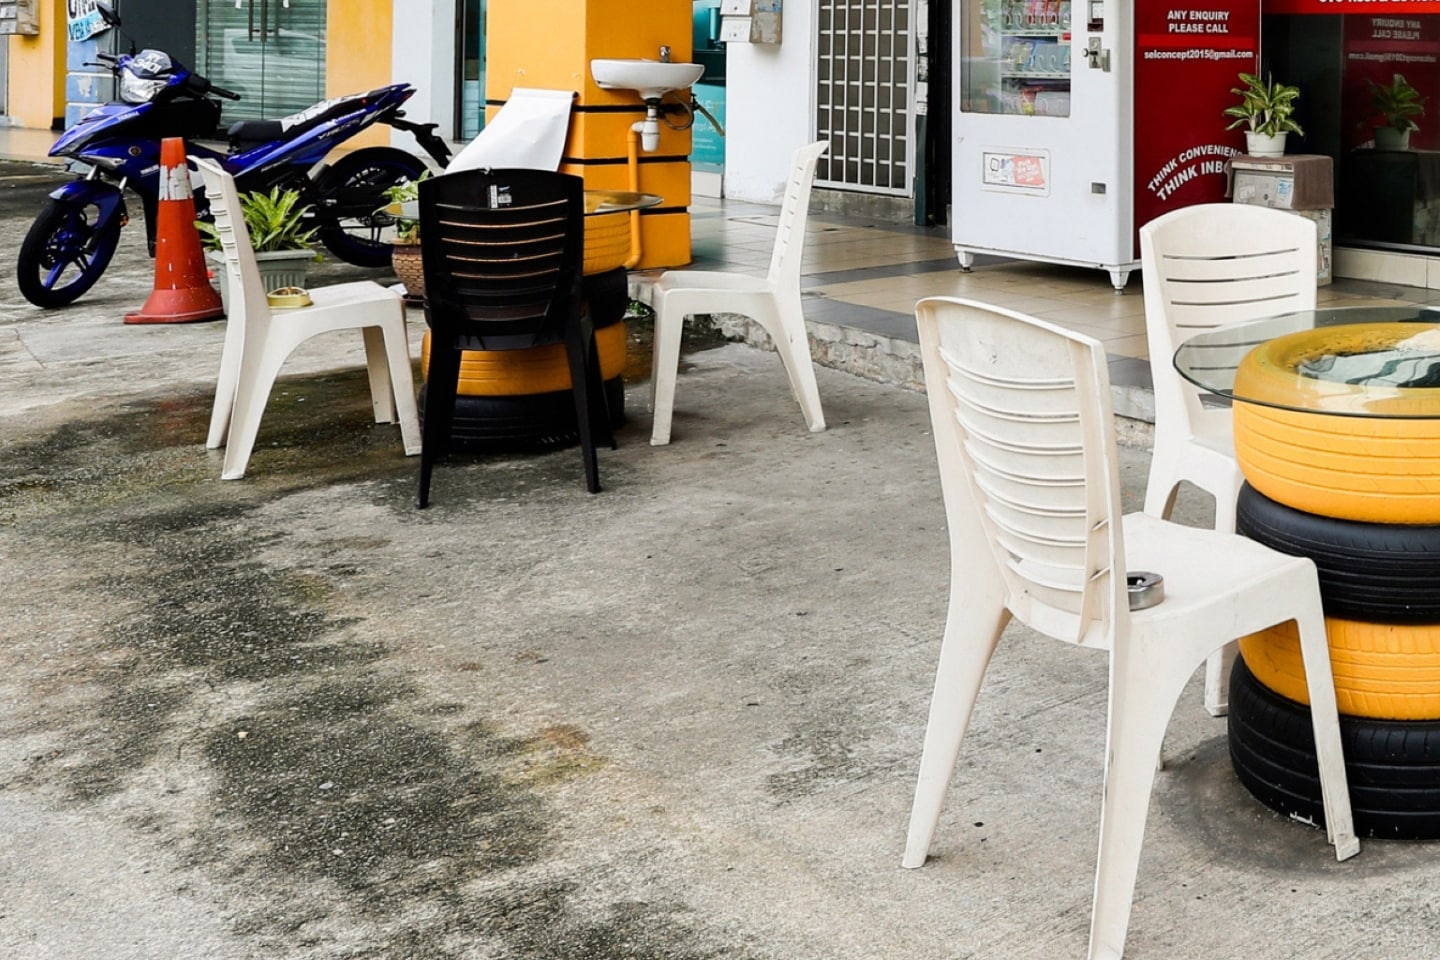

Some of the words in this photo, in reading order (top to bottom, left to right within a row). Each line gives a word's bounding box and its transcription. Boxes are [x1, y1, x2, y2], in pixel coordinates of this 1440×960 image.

[1167, 10, 1188, 20] ANY
[1189, 11, 1229, 21] ENQUIRY
[1168, 24, 1204, 33] PLEASE
[1205, 24, 1228, 33] CALL
[1144, 50, 1253, 61] selconcept2015@gmail.com
[1147, 158, 1178, 192] THINK
[1179, 144, 1243, 163] CONVENIEN
[1156, 165, 1198, 201] THINK
